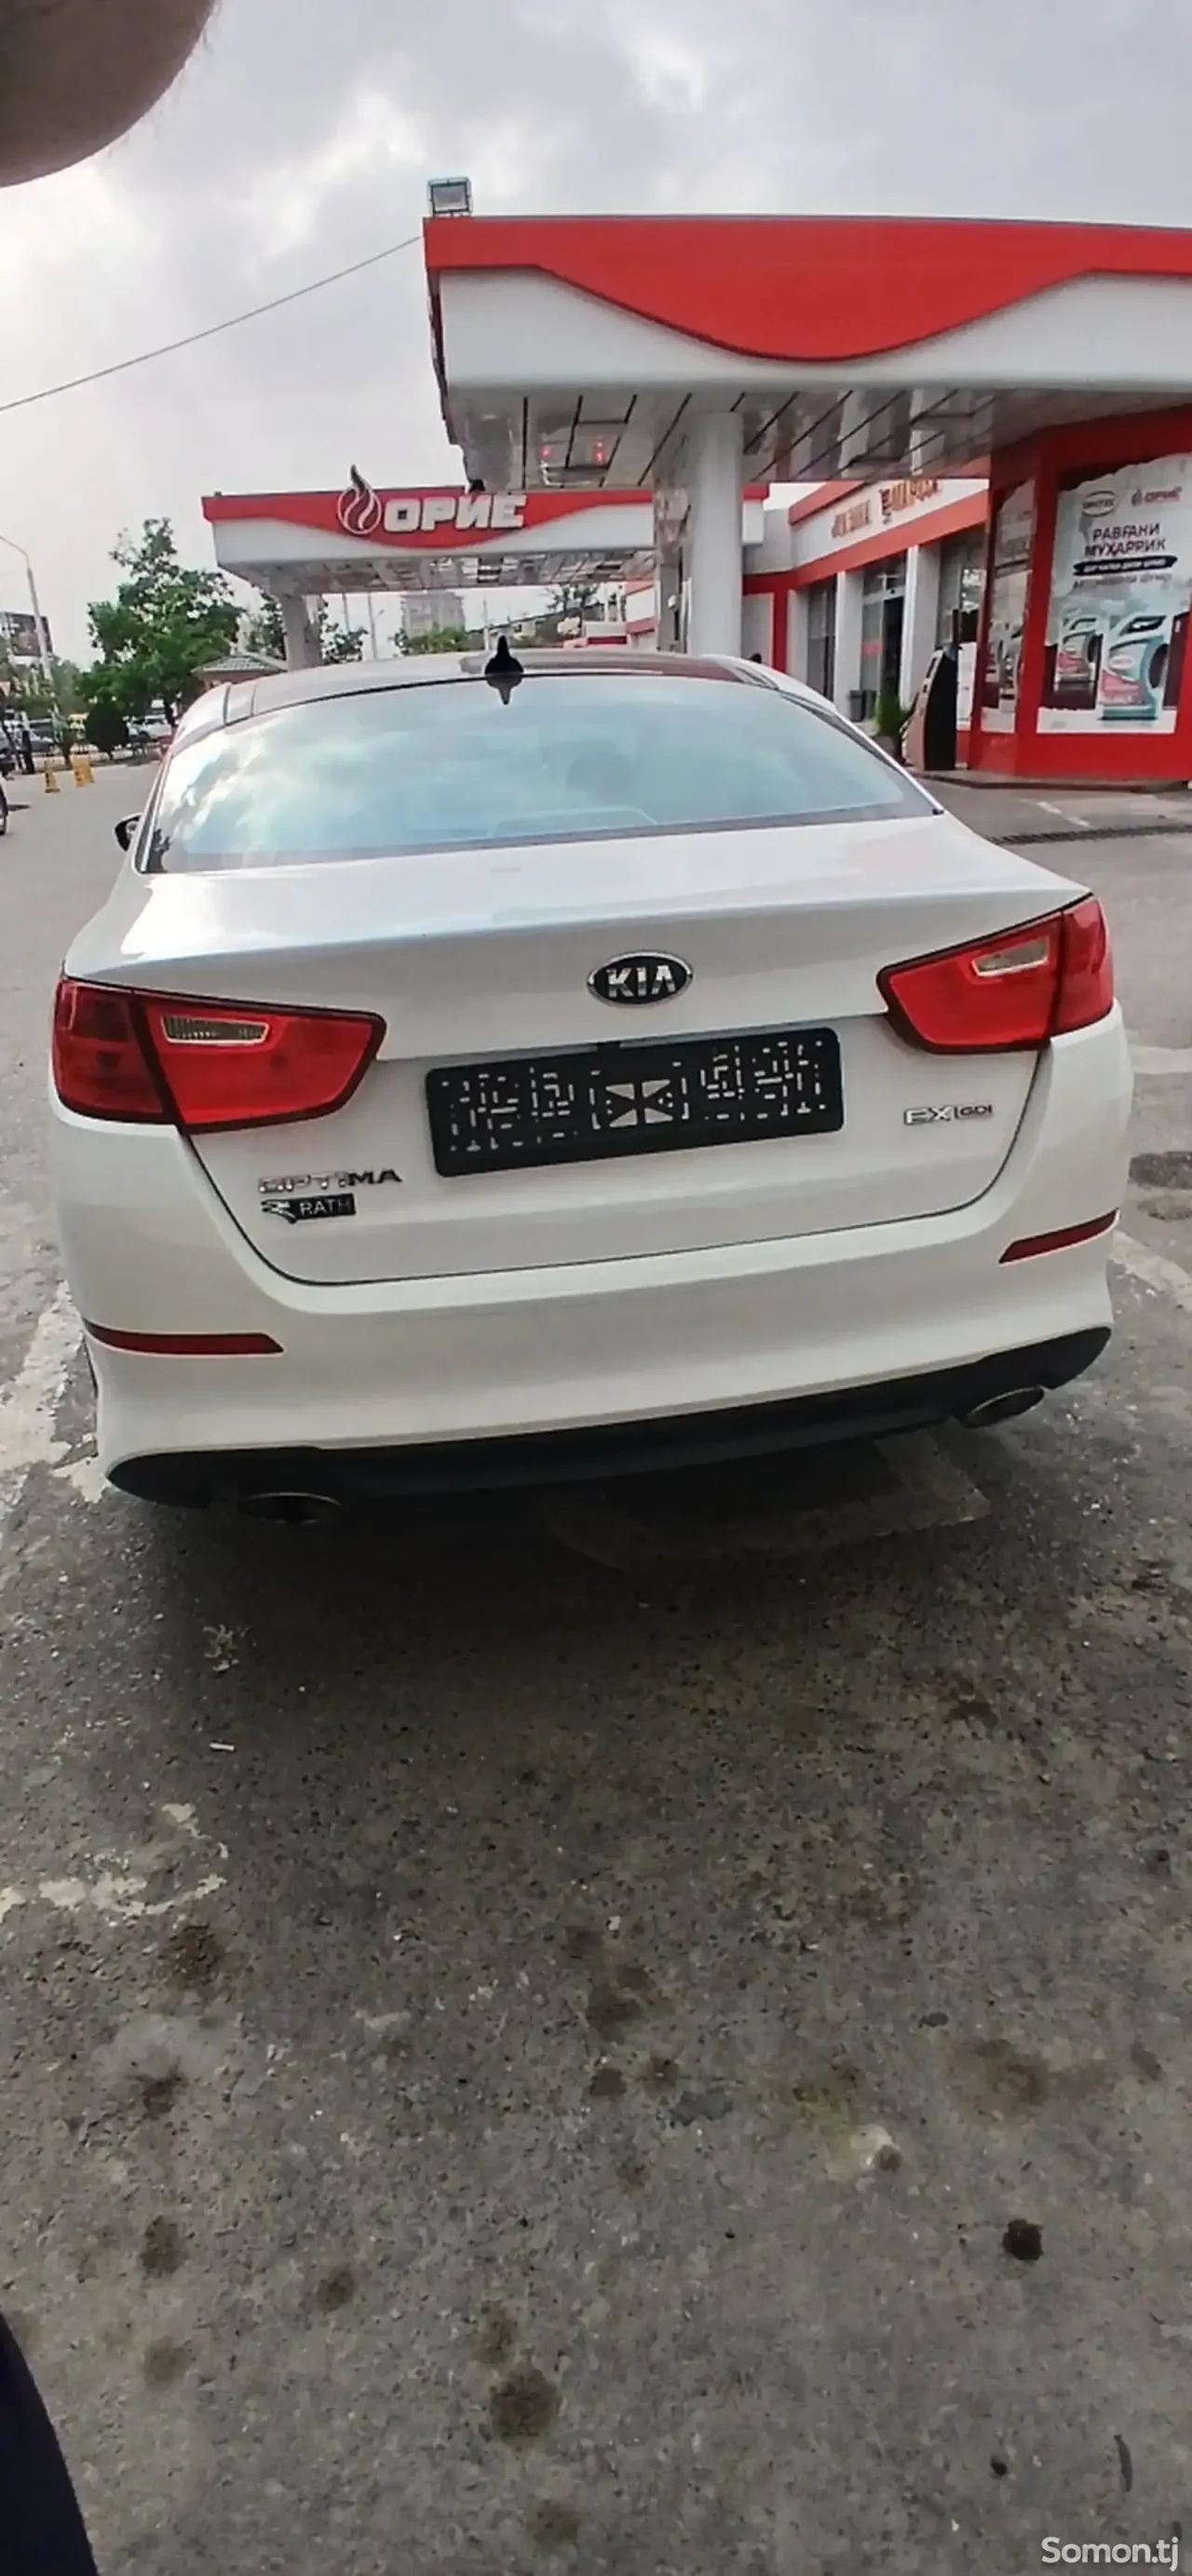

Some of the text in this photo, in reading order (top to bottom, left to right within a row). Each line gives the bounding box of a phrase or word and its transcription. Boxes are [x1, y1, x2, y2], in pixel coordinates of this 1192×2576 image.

[606, 964, 676, 998] KIA
[903, 1105, 951, 1126] EX
[258, 1168, 403, 1194] OPTIMA
